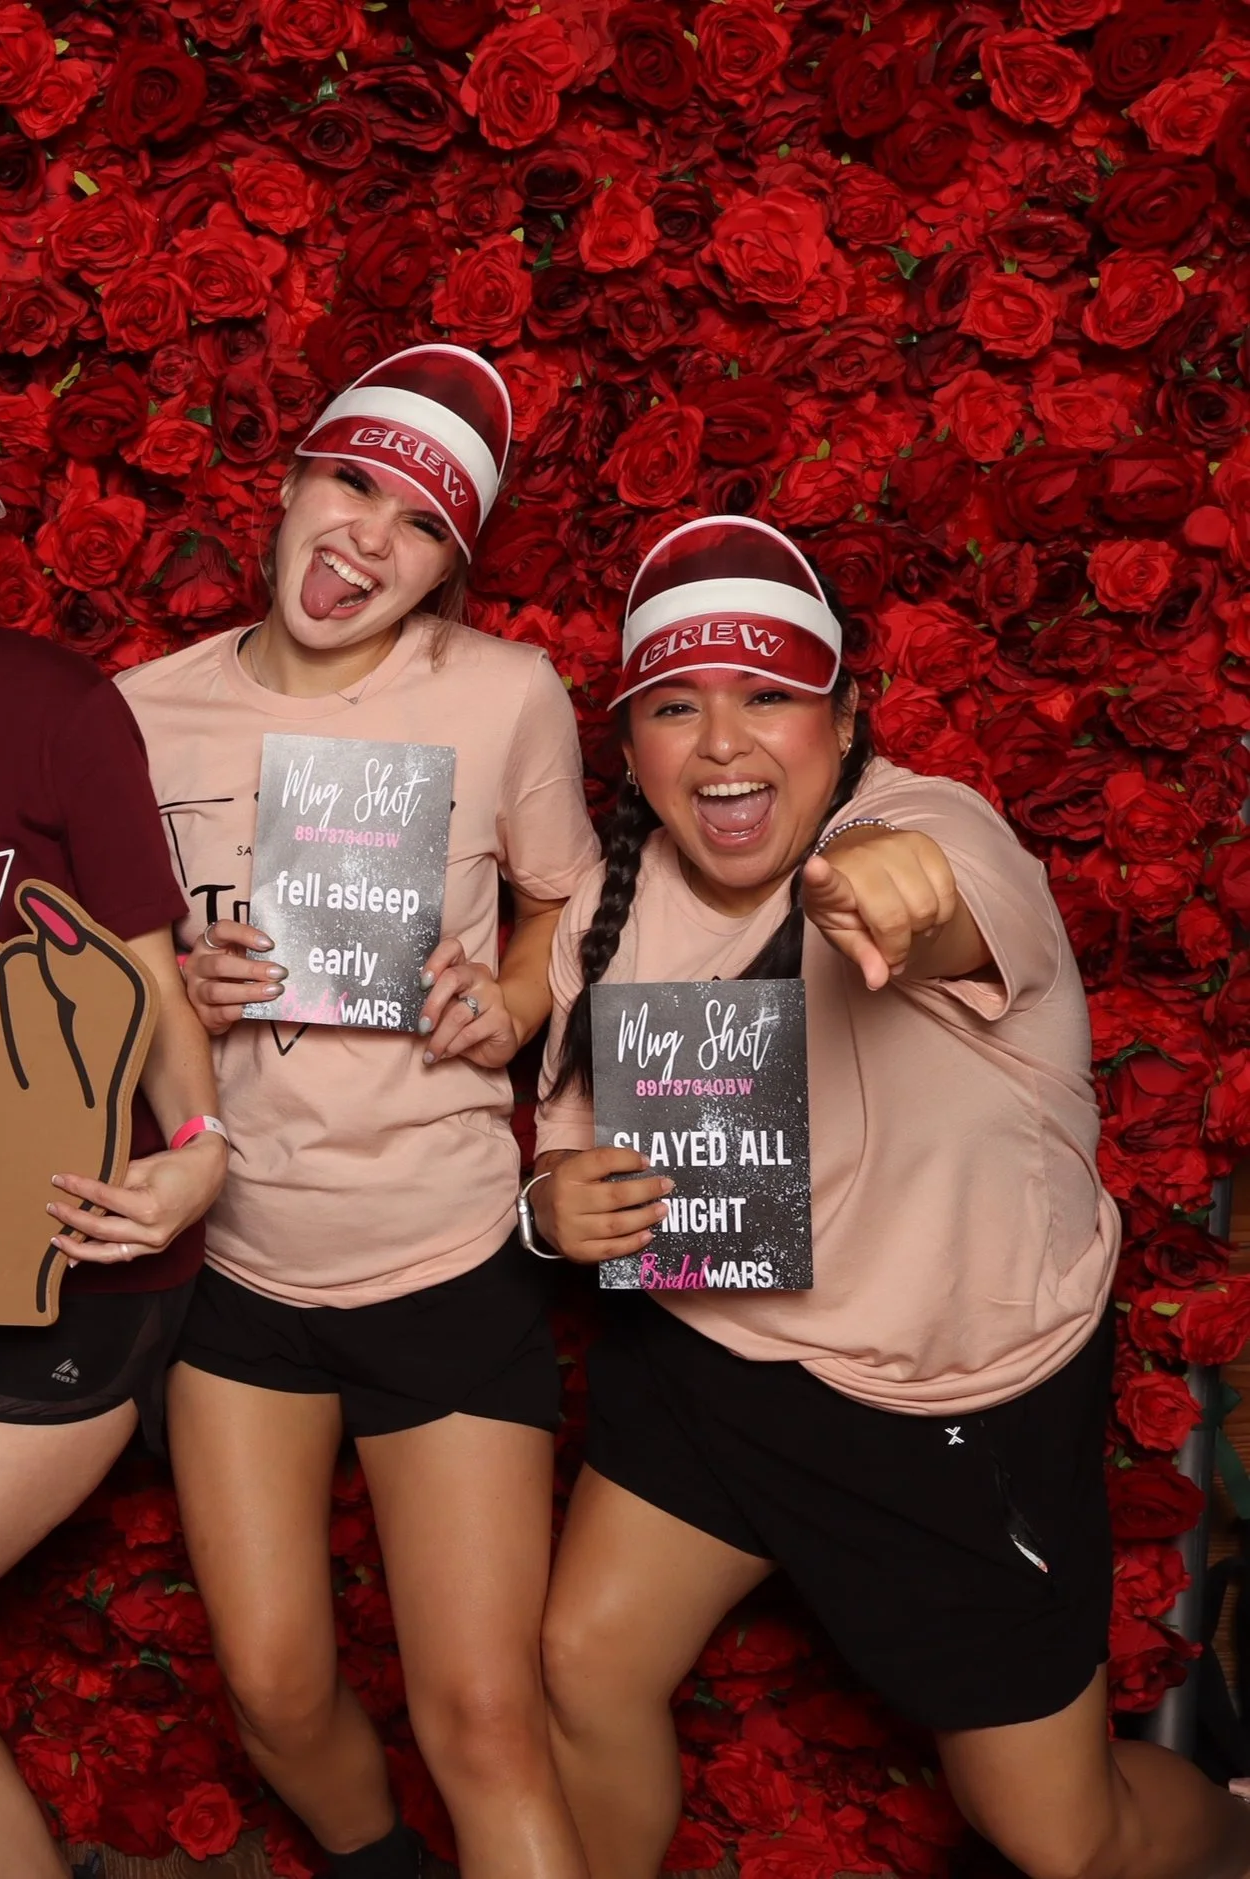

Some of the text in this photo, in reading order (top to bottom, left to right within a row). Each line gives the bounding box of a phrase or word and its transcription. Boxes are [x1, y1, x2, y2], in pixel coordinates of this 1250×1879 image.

[350, 428, 468, 506] CREW
[640, 620, 784, 672] CREW
[282, 755, 430, 830] Mug Shot
[276, 870, 321, 908] fell
[327, 876, 420, 923] asleep
[308, 942, 379, 987] early
[618, 999, 779, 1085] Mug Shot
[739, 1130, 792, 1166] ALL
[661, 1198, 746, 1233] NIGHT
[704, 1261, 774, 1288] WARS
